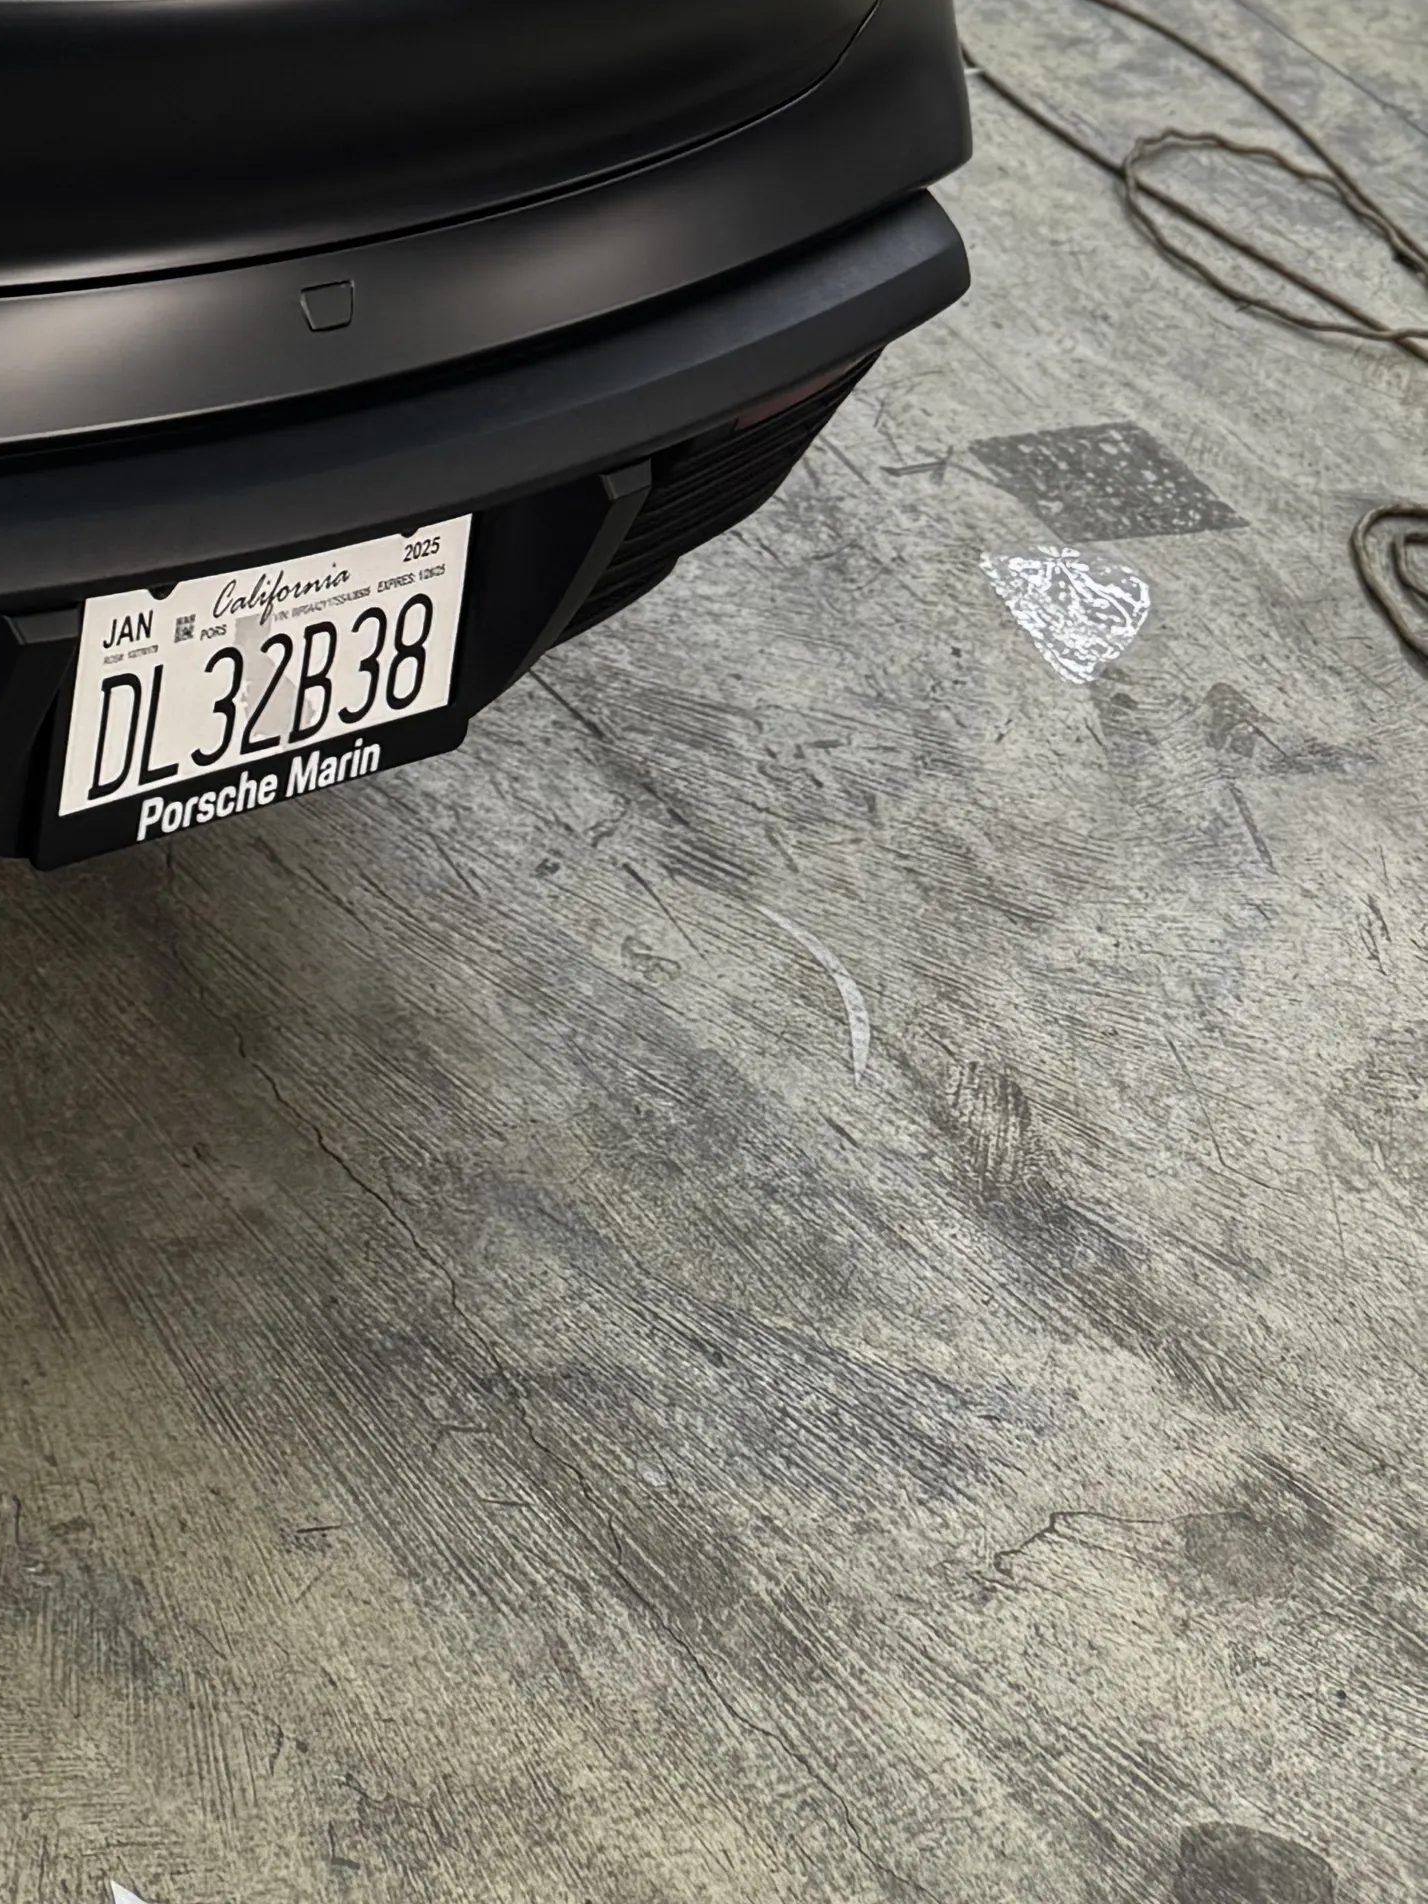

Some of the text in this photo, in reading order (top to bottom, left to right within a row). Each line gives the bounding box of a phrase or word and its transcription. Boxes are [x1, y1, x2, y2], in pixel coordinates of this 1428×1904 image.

[402, 536, 441, 563] 2025
[212, 563, 351, 622] California
[103, 609, 153, 649] JAN
[87, 593, 434, 800] DL32B38
[137, 738, 381, 842] Porsche Marin
